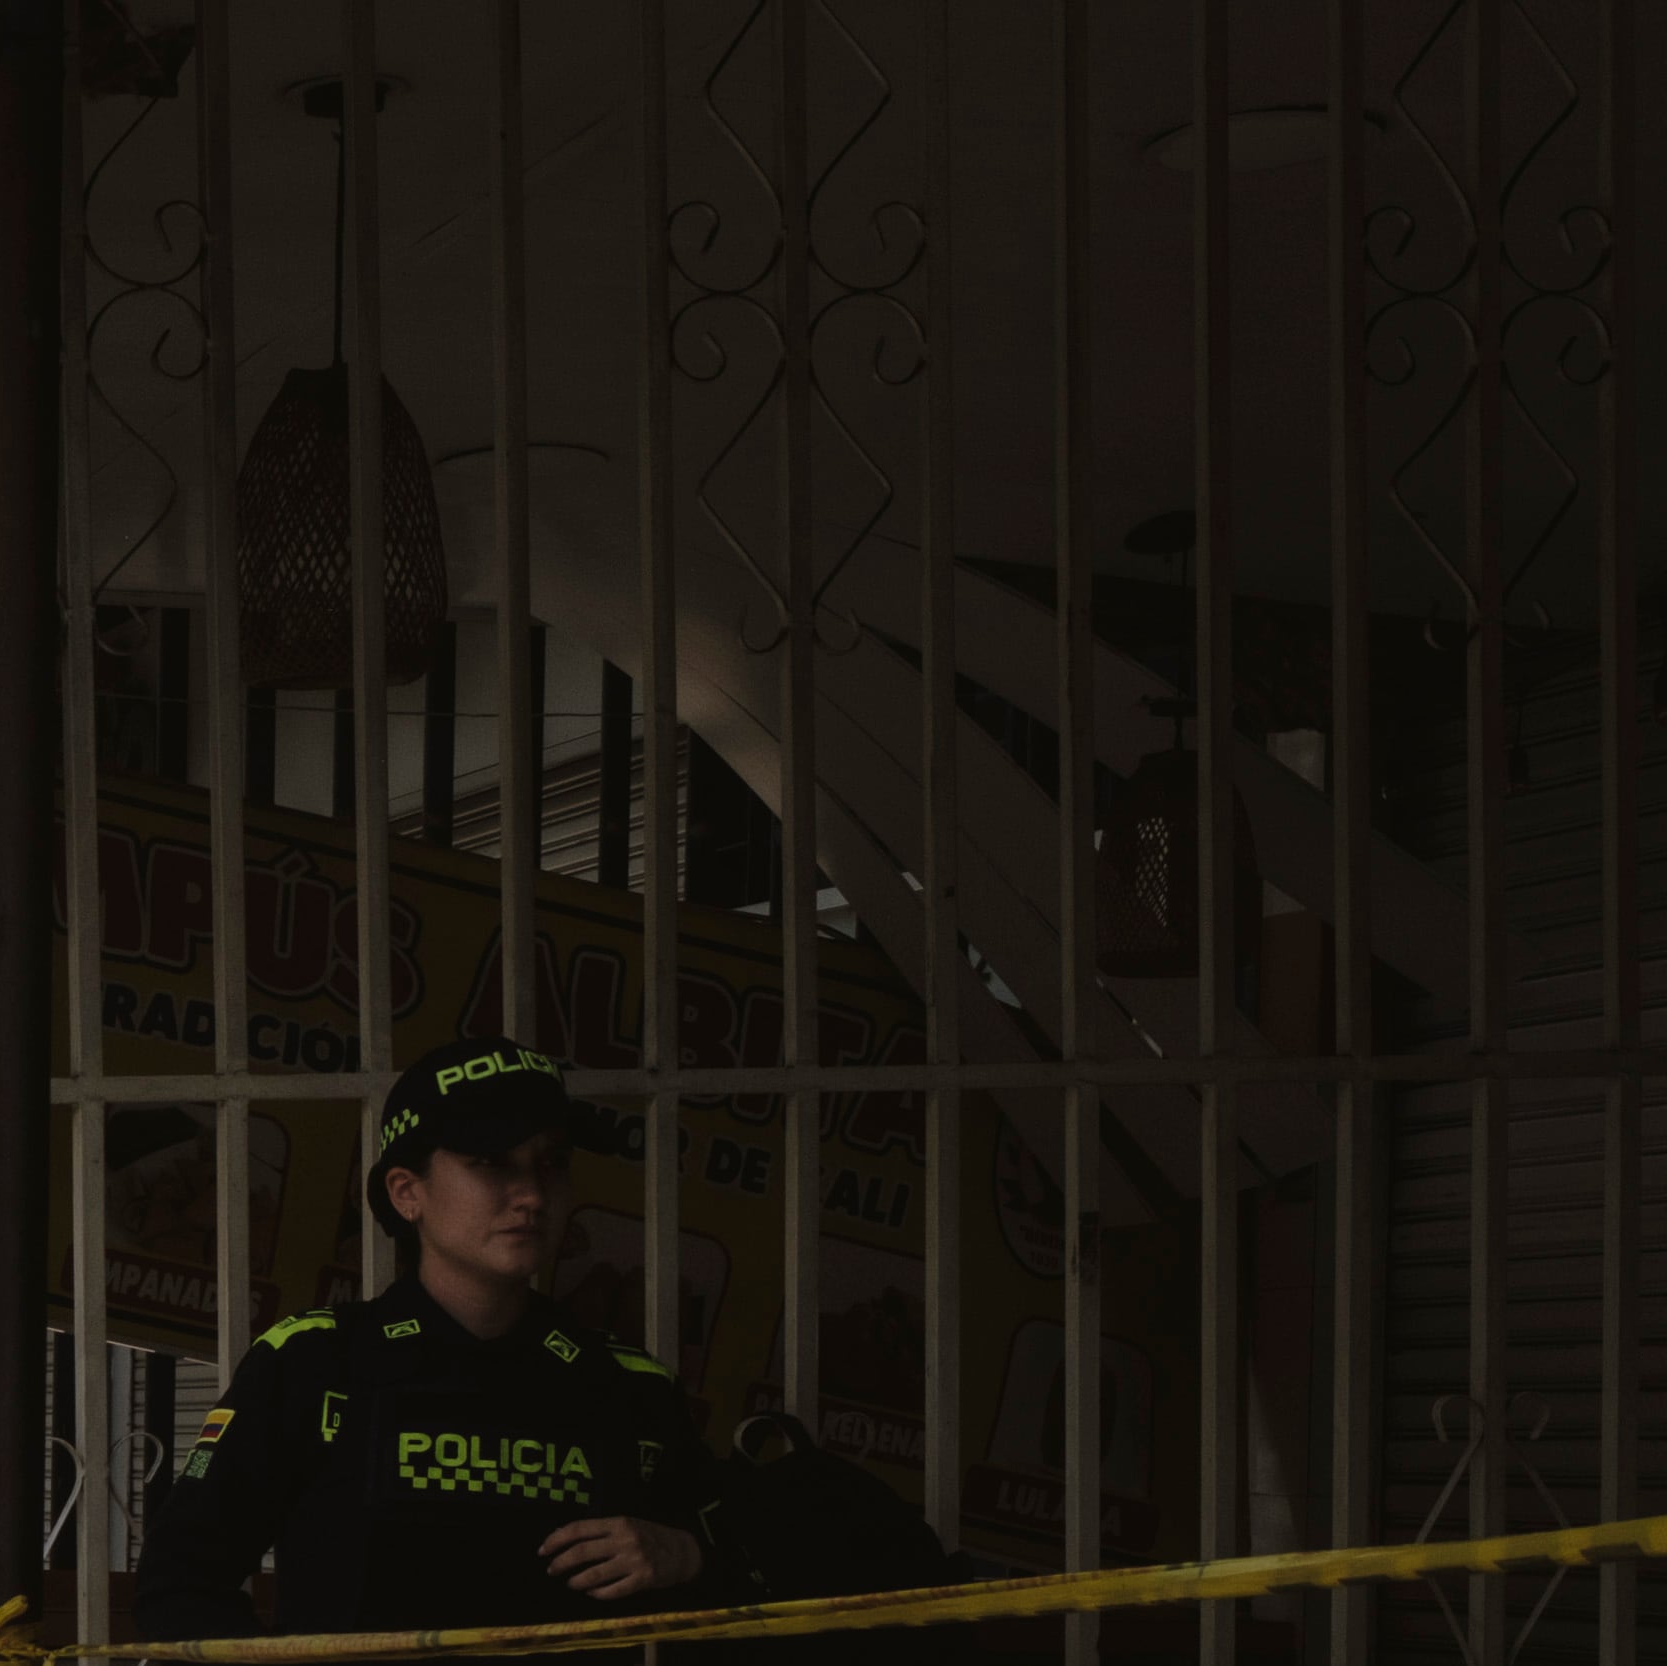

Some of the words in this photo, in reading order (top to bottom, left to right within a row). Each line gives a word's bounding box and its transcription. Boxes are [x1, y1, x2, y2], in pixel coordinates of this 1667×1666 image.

[704, 1137, 771, 1195] DE
[819, 1167, 910, 1228] ALI
[398, 1431, 594, 1480] POLICIA
